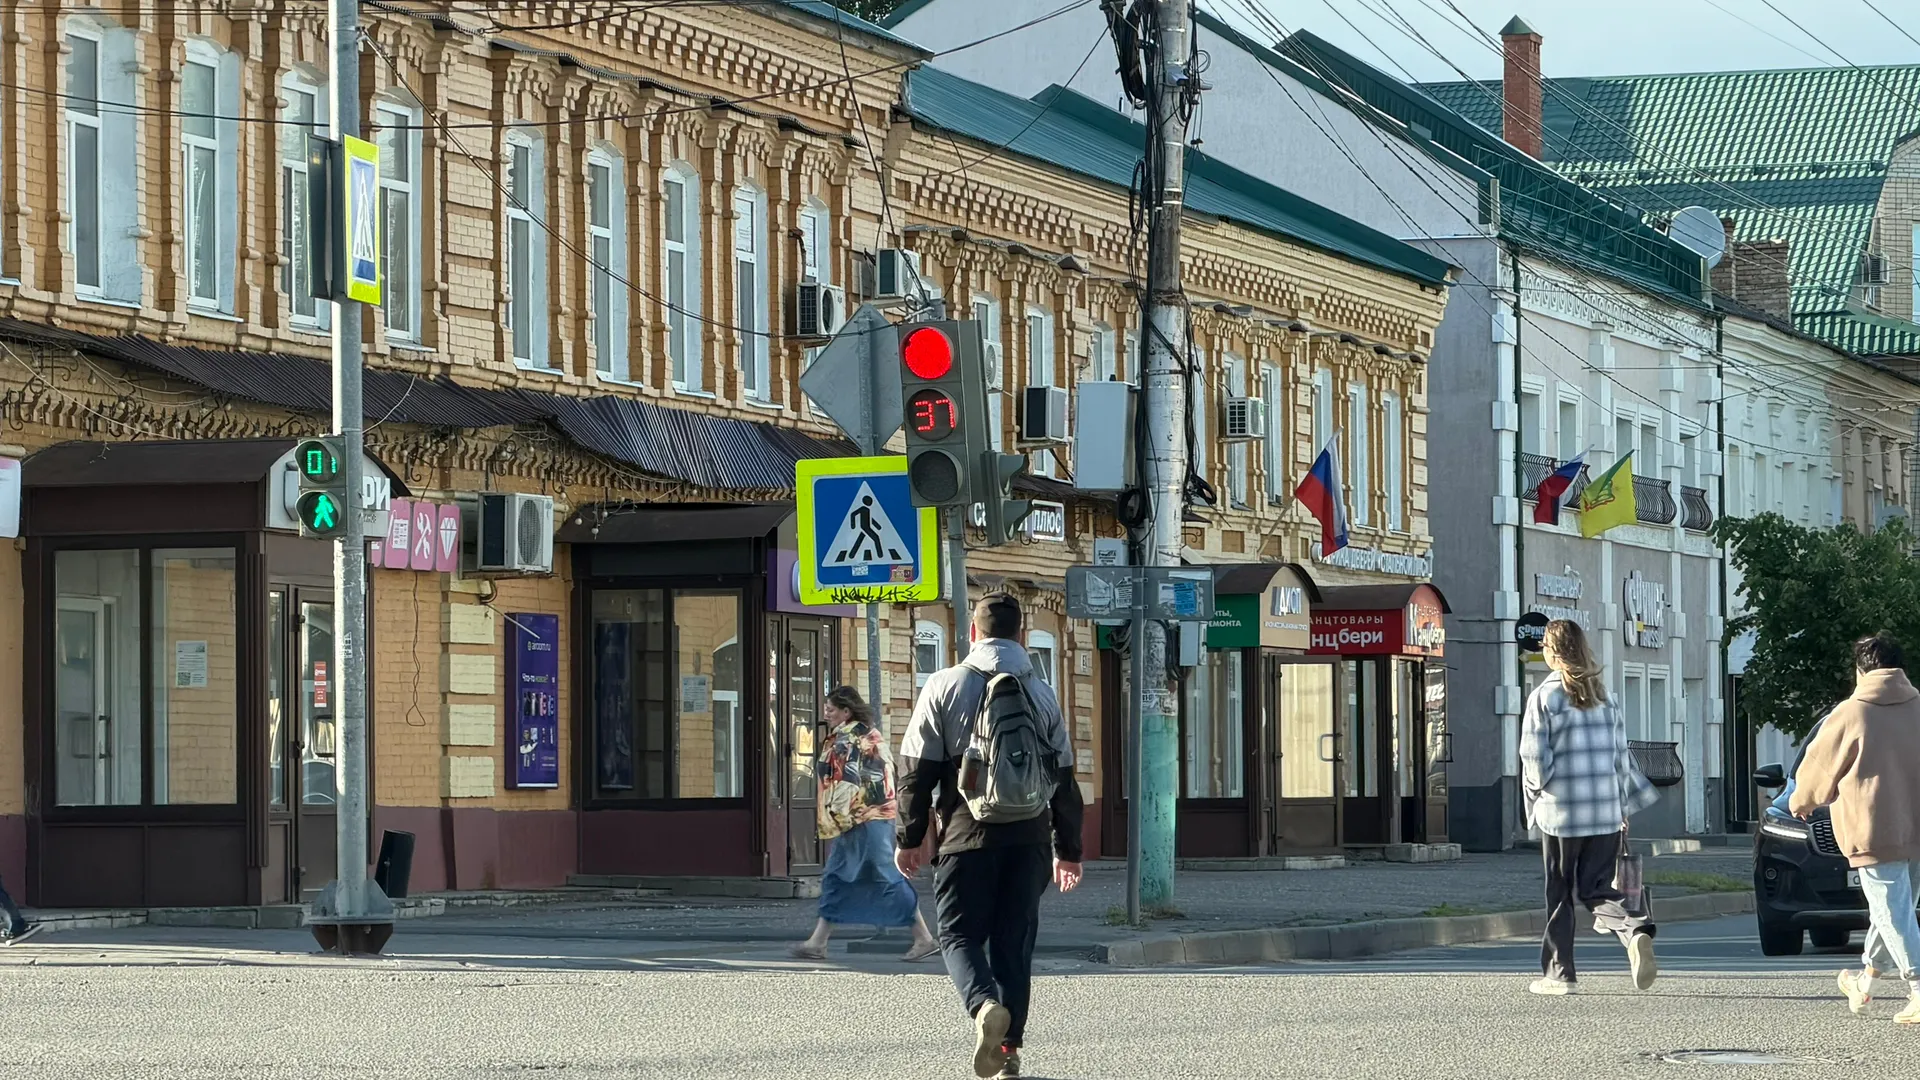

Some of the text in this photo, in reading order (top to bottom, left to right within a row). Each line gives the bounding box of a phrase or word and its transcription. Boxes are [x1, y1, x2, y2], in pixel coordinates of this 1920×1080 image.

[915, 399, 956, 432] 37
[363, 475, 391, 511] РИ
[1309, 615, 1383, 626] АНЦТОВАРЫ
[1311, 628, 1383, 650] нцбери
